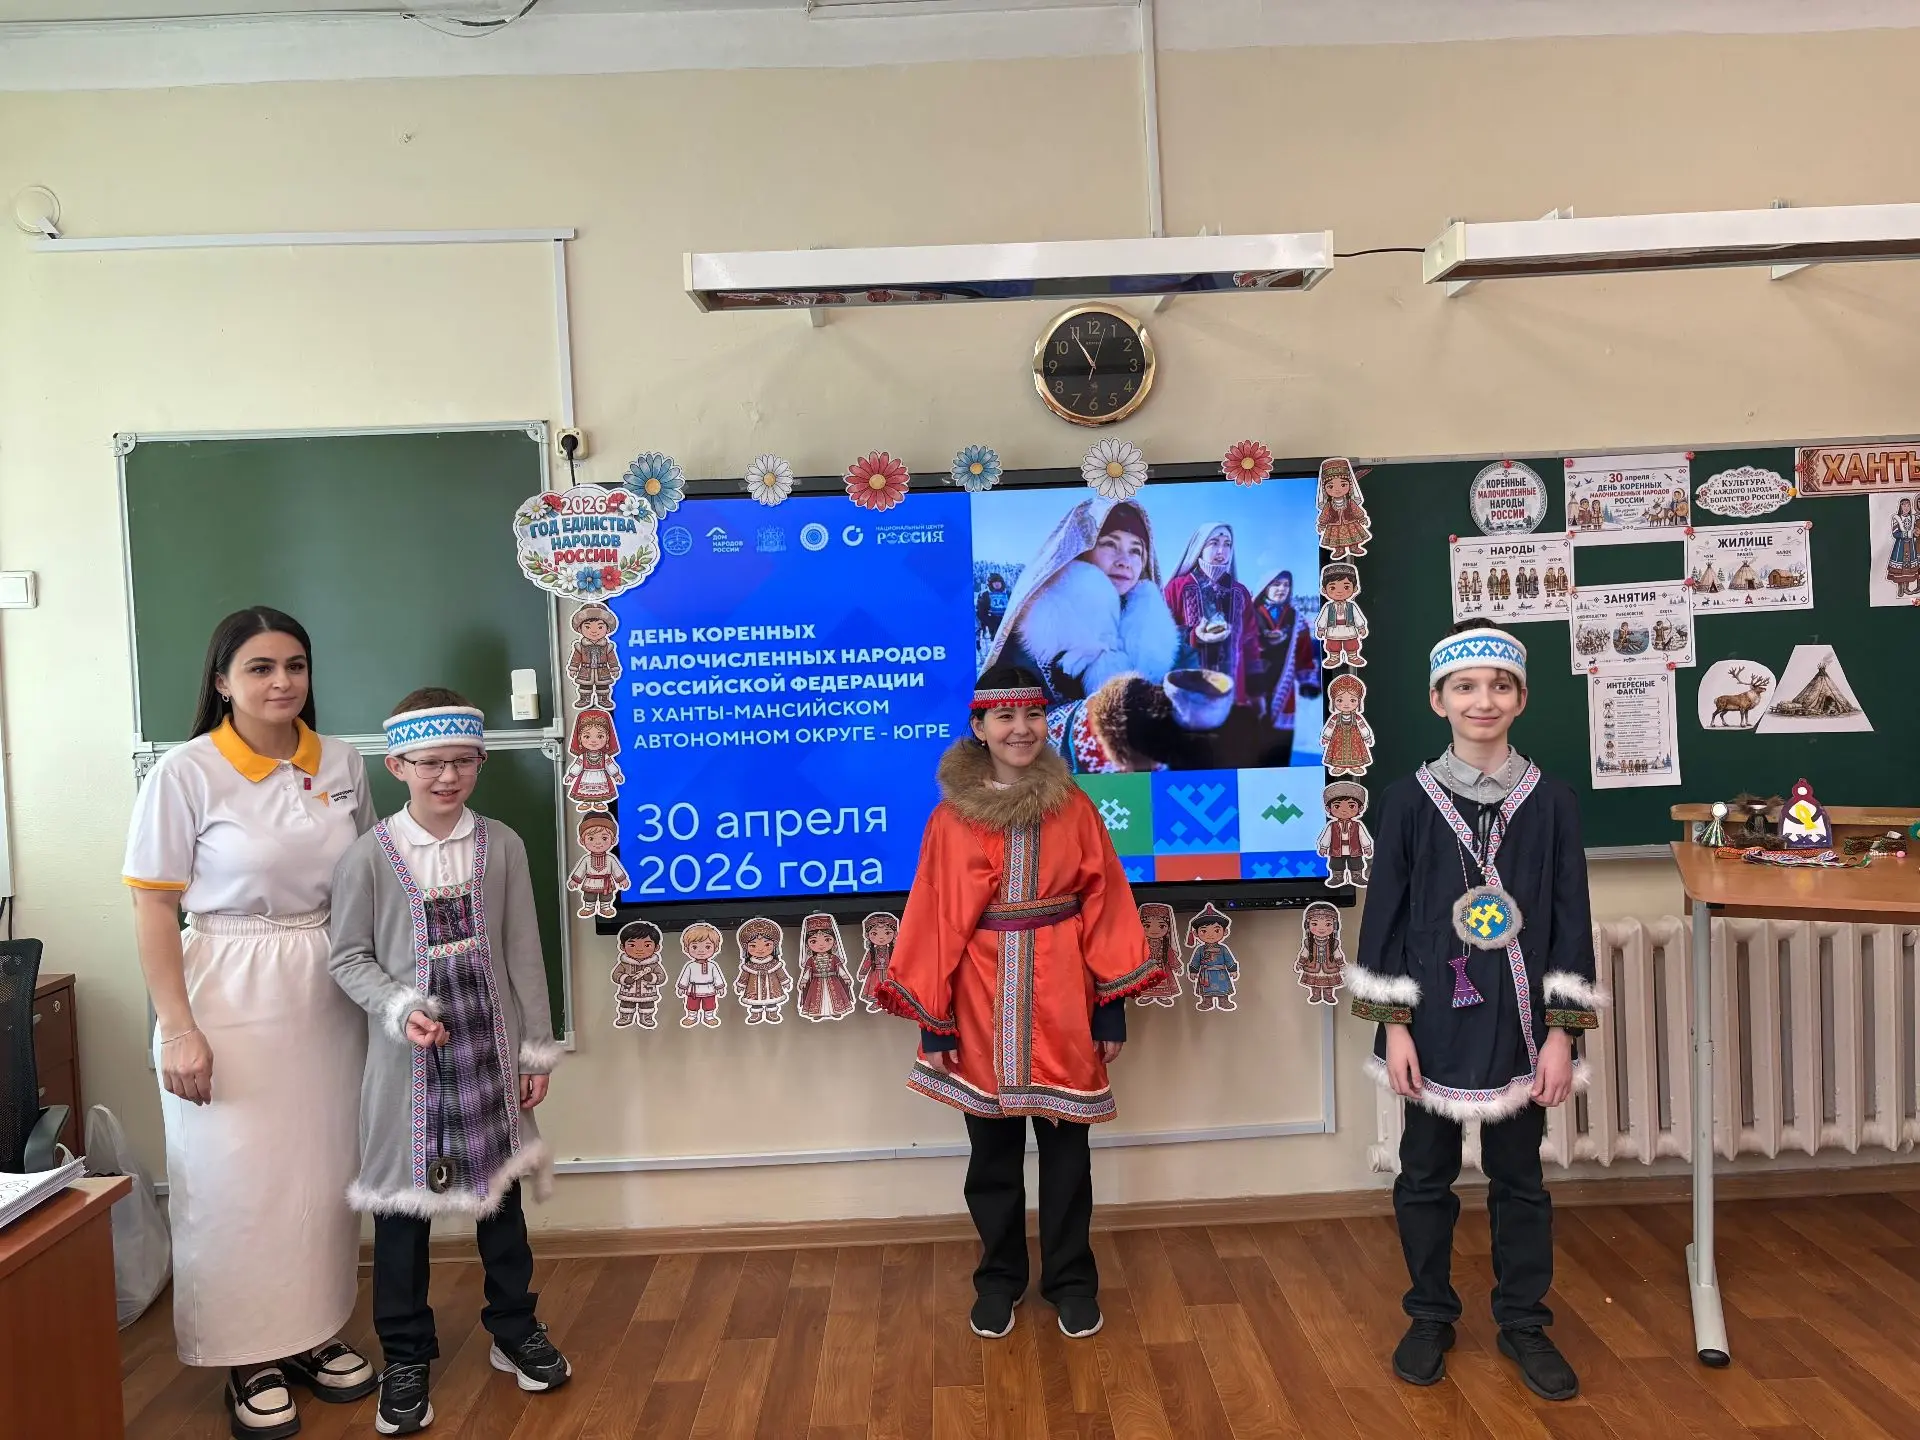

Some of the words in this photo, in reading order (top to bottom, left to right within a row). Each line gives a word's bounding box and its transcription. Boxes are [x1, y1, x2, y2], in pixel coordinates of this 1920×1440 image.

[1086, 321, 1100, 334] 12
[1111, 325, 1116, 337] 1
[1055, 341, 1069, 354] 10
[1123, 338, 1132, 352] 2
[1048, 360, 1058, 373] 9
[1129, 359, 1138, 372] 3
[1055, 380, 1064, 393] 8
[1123, 379, 1132, 392] 4
[1071, 394, 1081, 406] 7
[1088, 397, 1098, 411] 6
[1108, 393, 1118, 406] 5
[1486, 477, 1526, 489] КОРЕННЫЕ
[1609, 473, 1623, 483] 30
[1625, 474, 1650, 482] апреля
[1478, 487, 1537, 499] МАЛОЧИСЛЕННЫЕ
[1597, 484, 1618, 492] ДЕНЬ
[1620, 482, 1662, 490] КОРЕННЫХ
[1590, 490, 1641, 498] МАЛОЧИСЛЕННЫХ
[1710, 495, 1750, 504] БОГАТСТВО
[561, 496, 607, 515] 2026
[1490, 498, 1525, 509] НАРОДЫ
[1491, 509, 1525, 520] РОССИИ
[530, 519, 559, 538] ГОД
[561, 516, 637, 533] ЕДИНСТВА
[551, 534, 621, 550] НАРОДОВ
[1717, 536, 1773, 548] ЖИЛИЩЕ
[554, 548, 618, 565] РОССИИ
[1490, 545, 1535, 555] НАРОДЫ
[1603, 591, 1656, 604] ЗАНЯТИЯ
[628, 628, 687, 647] ДЕНЬ
[692, 624, 816, 643] КОРЕННЫХ
[630, 649, 836, 671] МАЛОЧИСЛЕННЫХ
[841, 646, 946, 665] НАРОДОВ
[632, 673, 785, 697] РОССИЙСКОЙ
[790, 672, 924, 693] ФЕДЕРАЦИИ
[1606, 680, 1655, 689] ИНТЕРЕСНЫЕ
[633, 708, 646, 723] В
[652, 698, 889, 722] ХАНТЫ-МАНСИЙСКОМ
[634, 729, 789, 749] АВТОНОМНОМ
[795, 726, 875, 744] ОКРУГЕ
[893, 723, 950, 740] ЮГРЕ
[636, 802, 700, 842] 30
[716, 806, 887, 847] апреля
[639, 852, 763, 894] 2026
[779, 857, 883, 893] года
